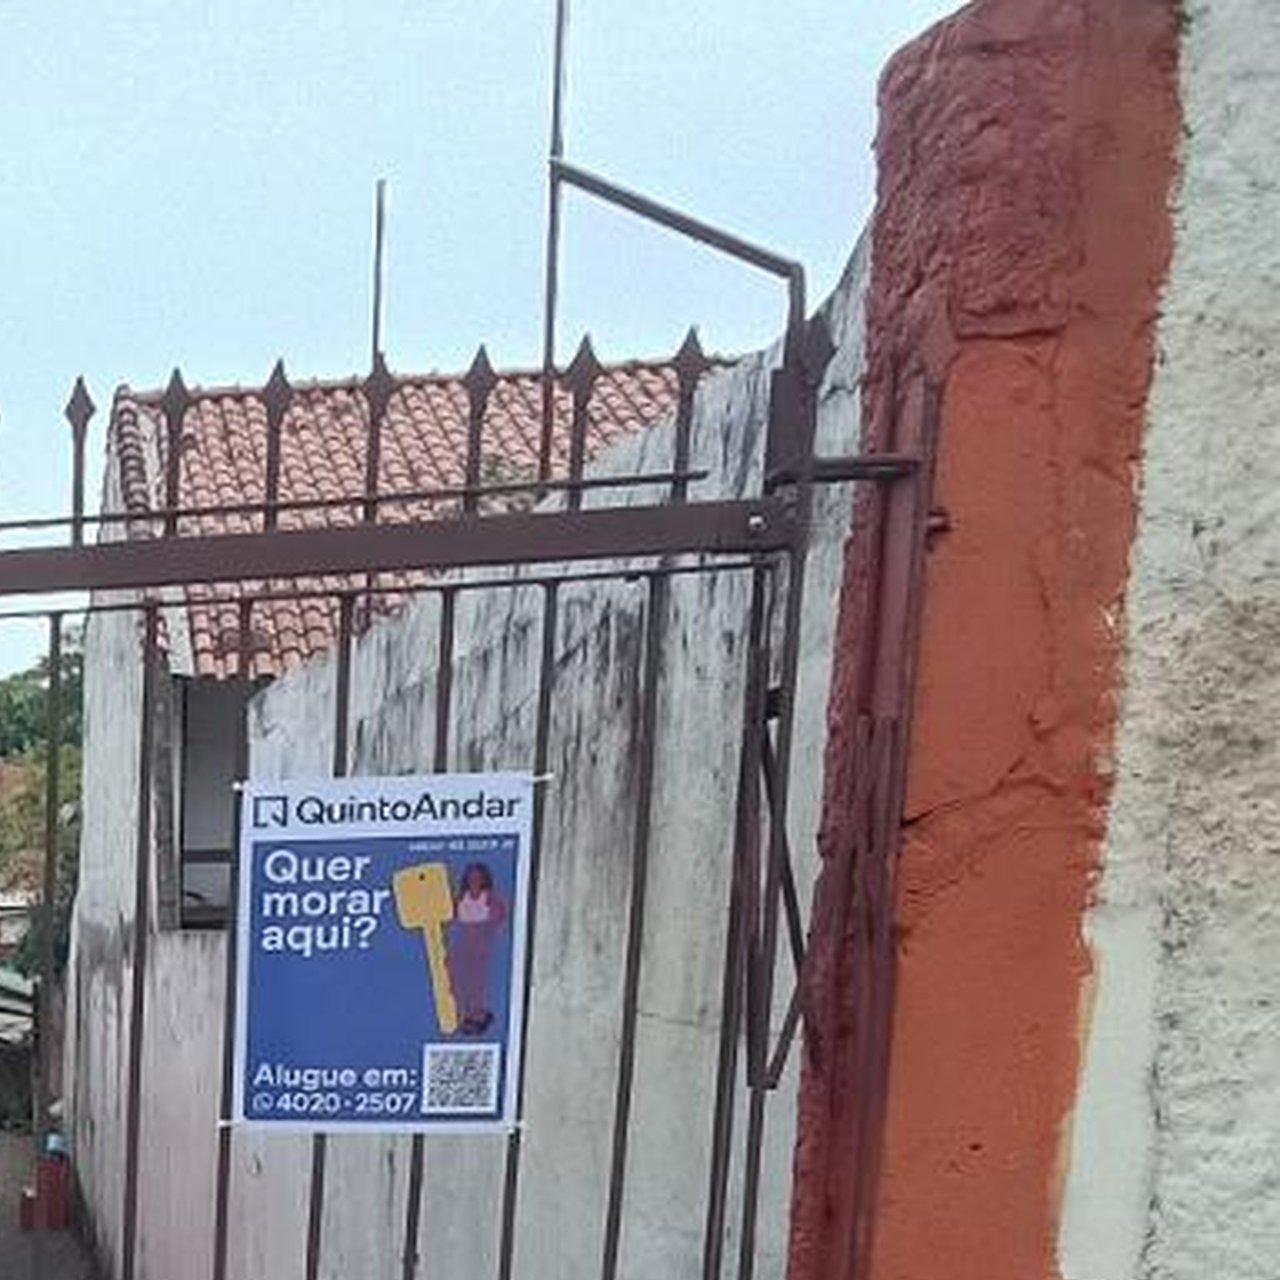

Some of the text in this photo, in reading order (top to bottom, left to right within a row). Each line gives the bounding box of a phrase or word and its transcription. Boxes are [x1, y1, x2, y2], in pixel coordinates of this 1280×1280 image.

[295, 790, 521, 825] QuintoAndar
[263, 848, 371, 883] Quer
[261, 888, 389, 917] morar
[260, 916, 378, 957] aqui?
[252, 1063, 418, 1091] Alugue em:
